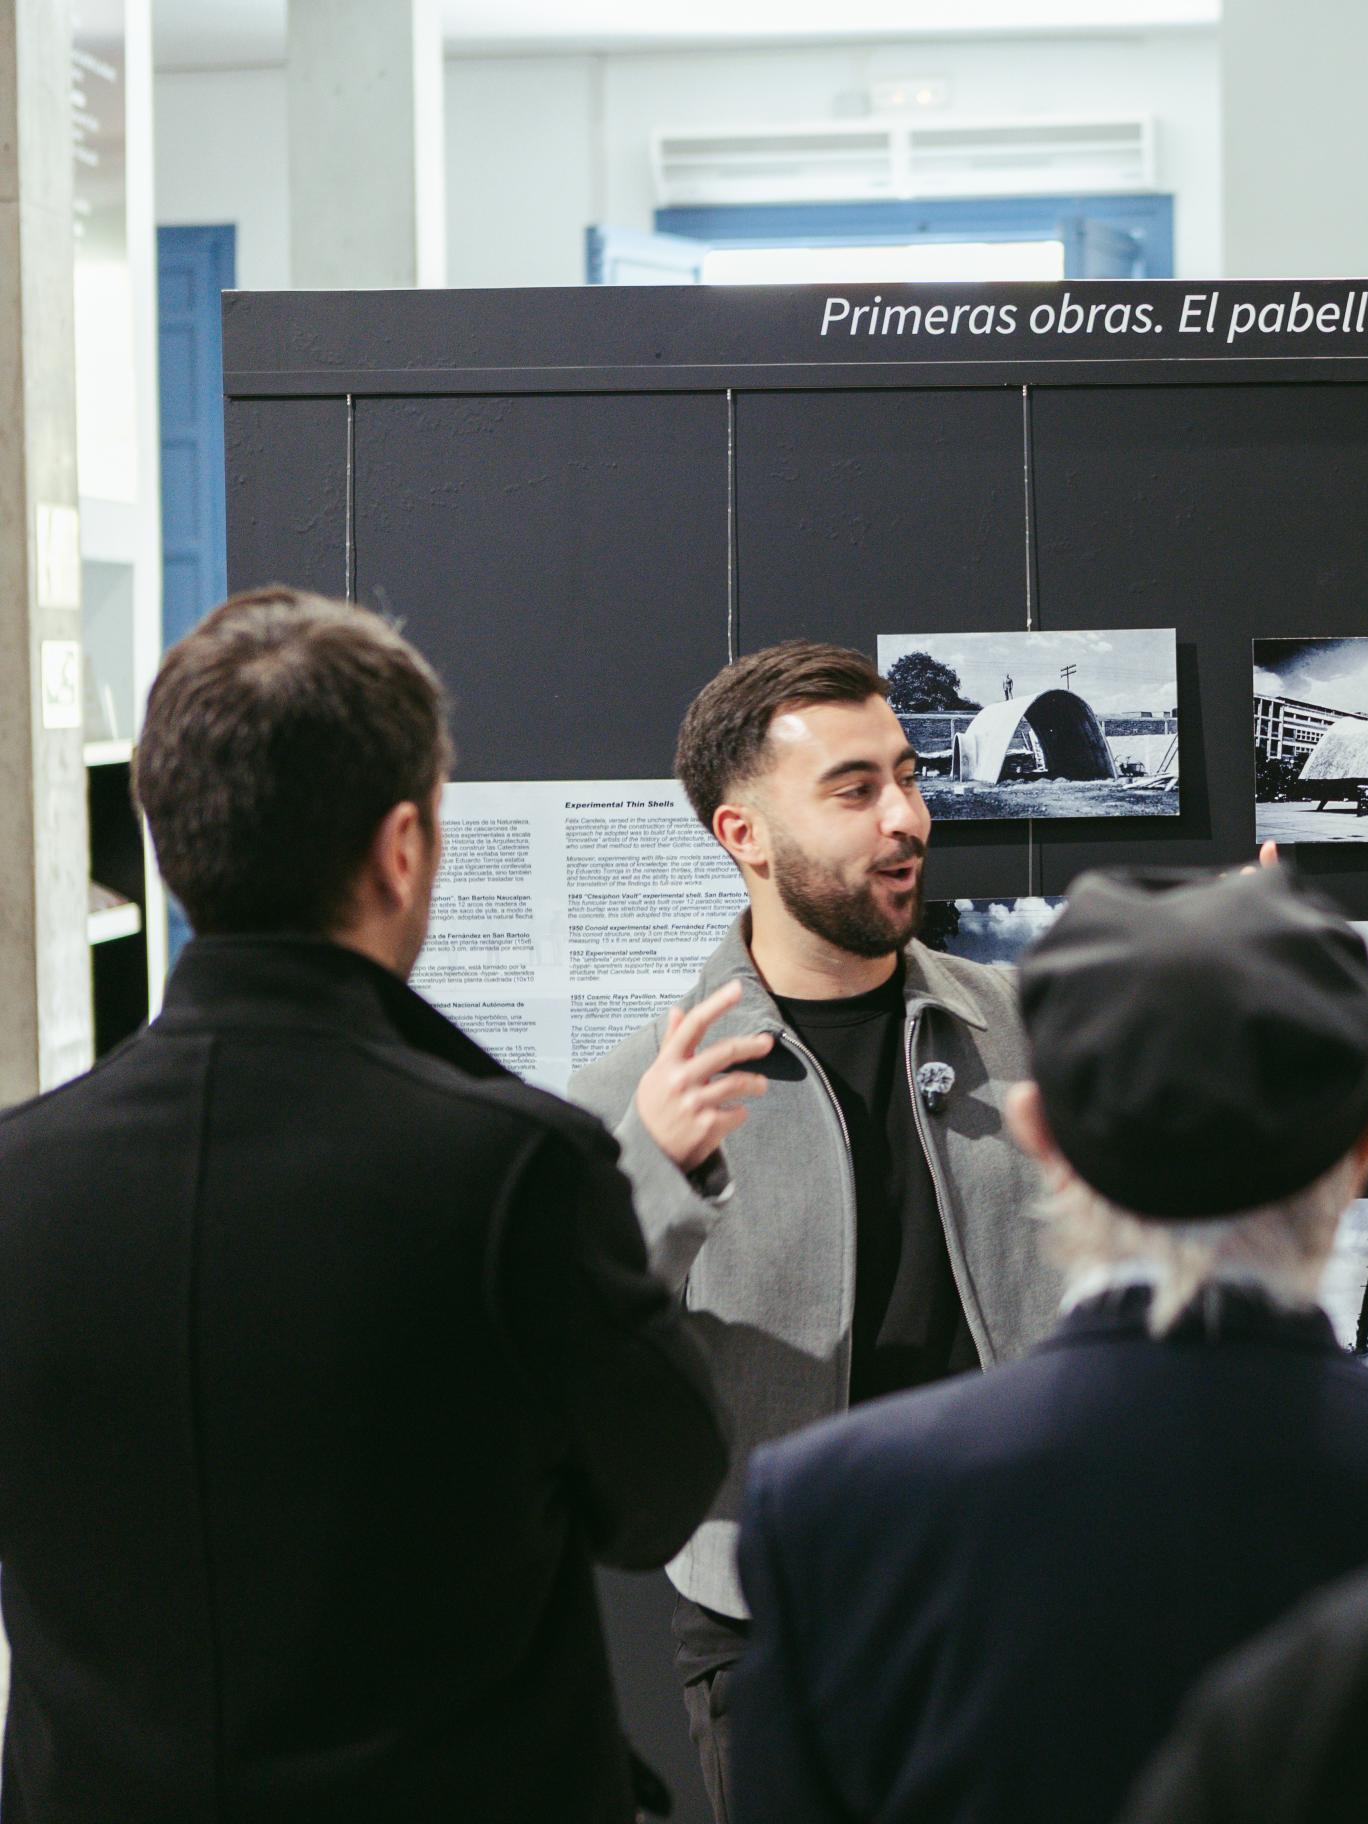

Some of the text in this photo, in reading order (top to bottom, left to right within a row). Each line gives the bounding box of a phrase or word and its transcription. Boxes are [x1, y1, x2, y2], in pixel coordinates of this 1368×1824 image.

[820, 295, 1018, 336] Primeras
[1029, 292, 1163, 334] obras.
[1178, 291, 1219, 333] El
[565, 801, 624, 809] Experimental
